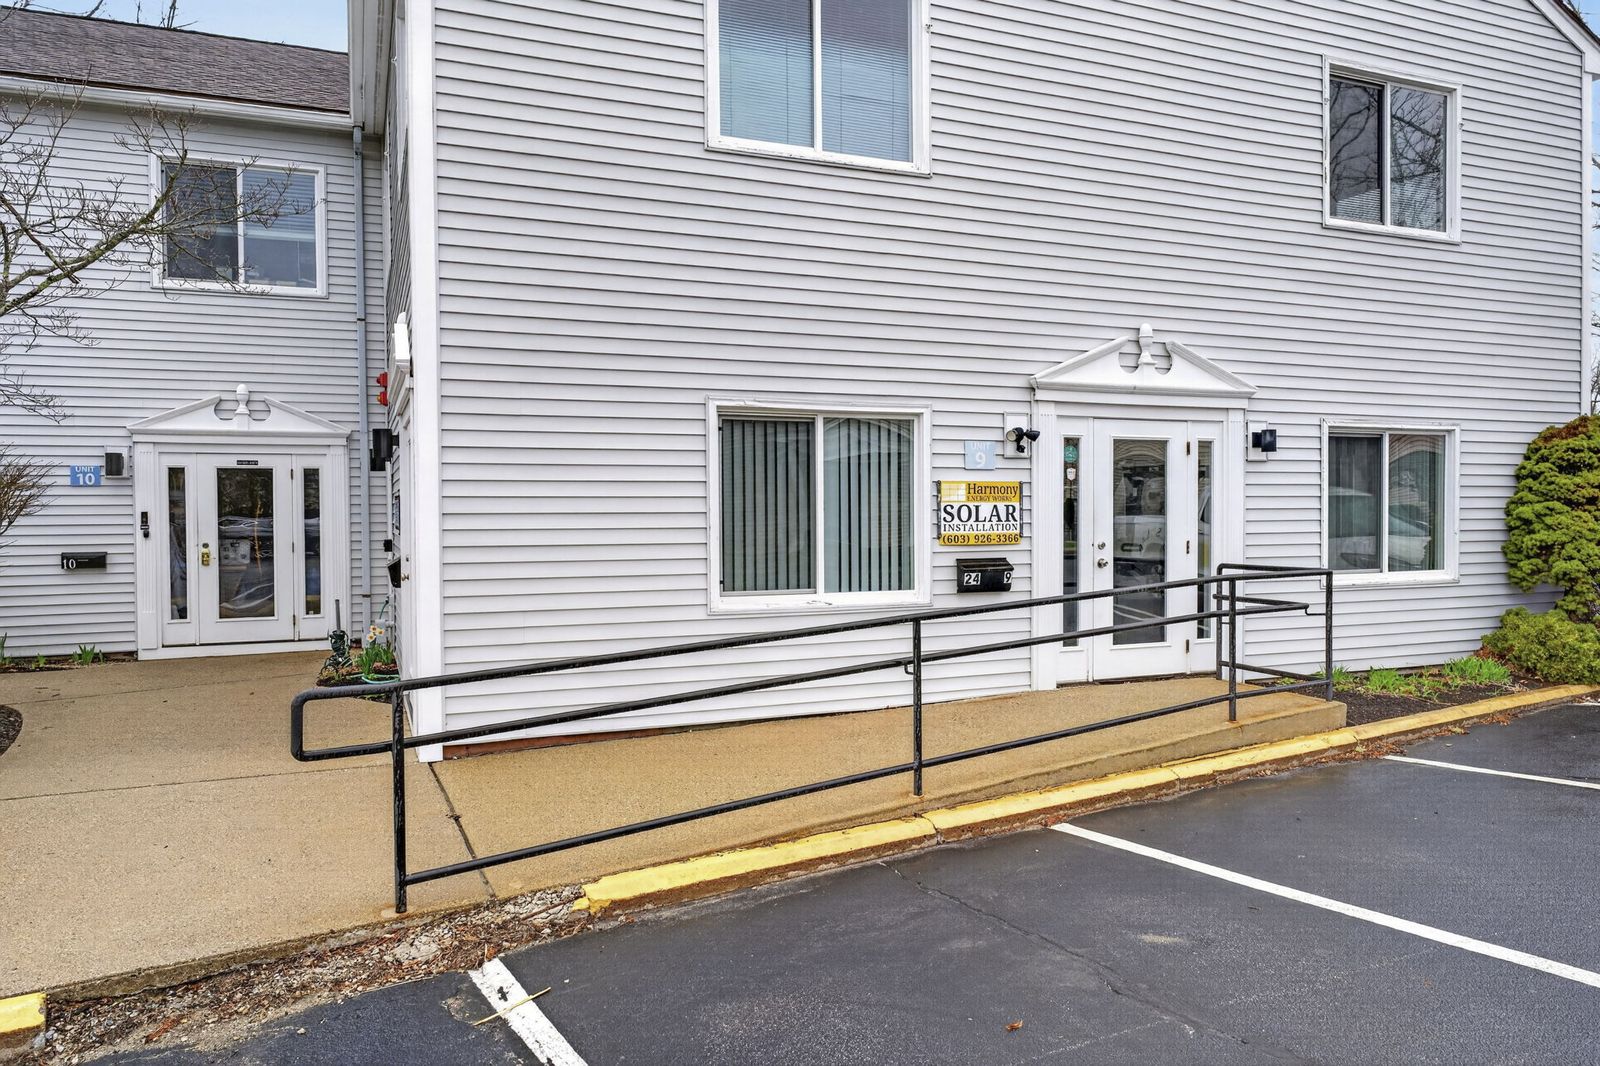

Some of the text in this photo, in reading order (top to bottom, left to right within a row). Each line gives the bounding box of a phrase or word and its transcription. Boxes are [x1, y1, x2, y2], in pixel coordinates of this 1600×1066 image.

[976, 452, 986, 468] 9
[76, 474, 95, 485] 10
[968, 484, 1018, 498] Harmony
[943, 504, 1018, 522] SOLAR
[944, 524, 1018, 532] INSTALLATION
[943, 534, 1018, 544] (603) 926-3366
[63, 559, 76, 570] 10
[965, 574, 980, 584] 24
[1005, 572, 1012, 582] 9
